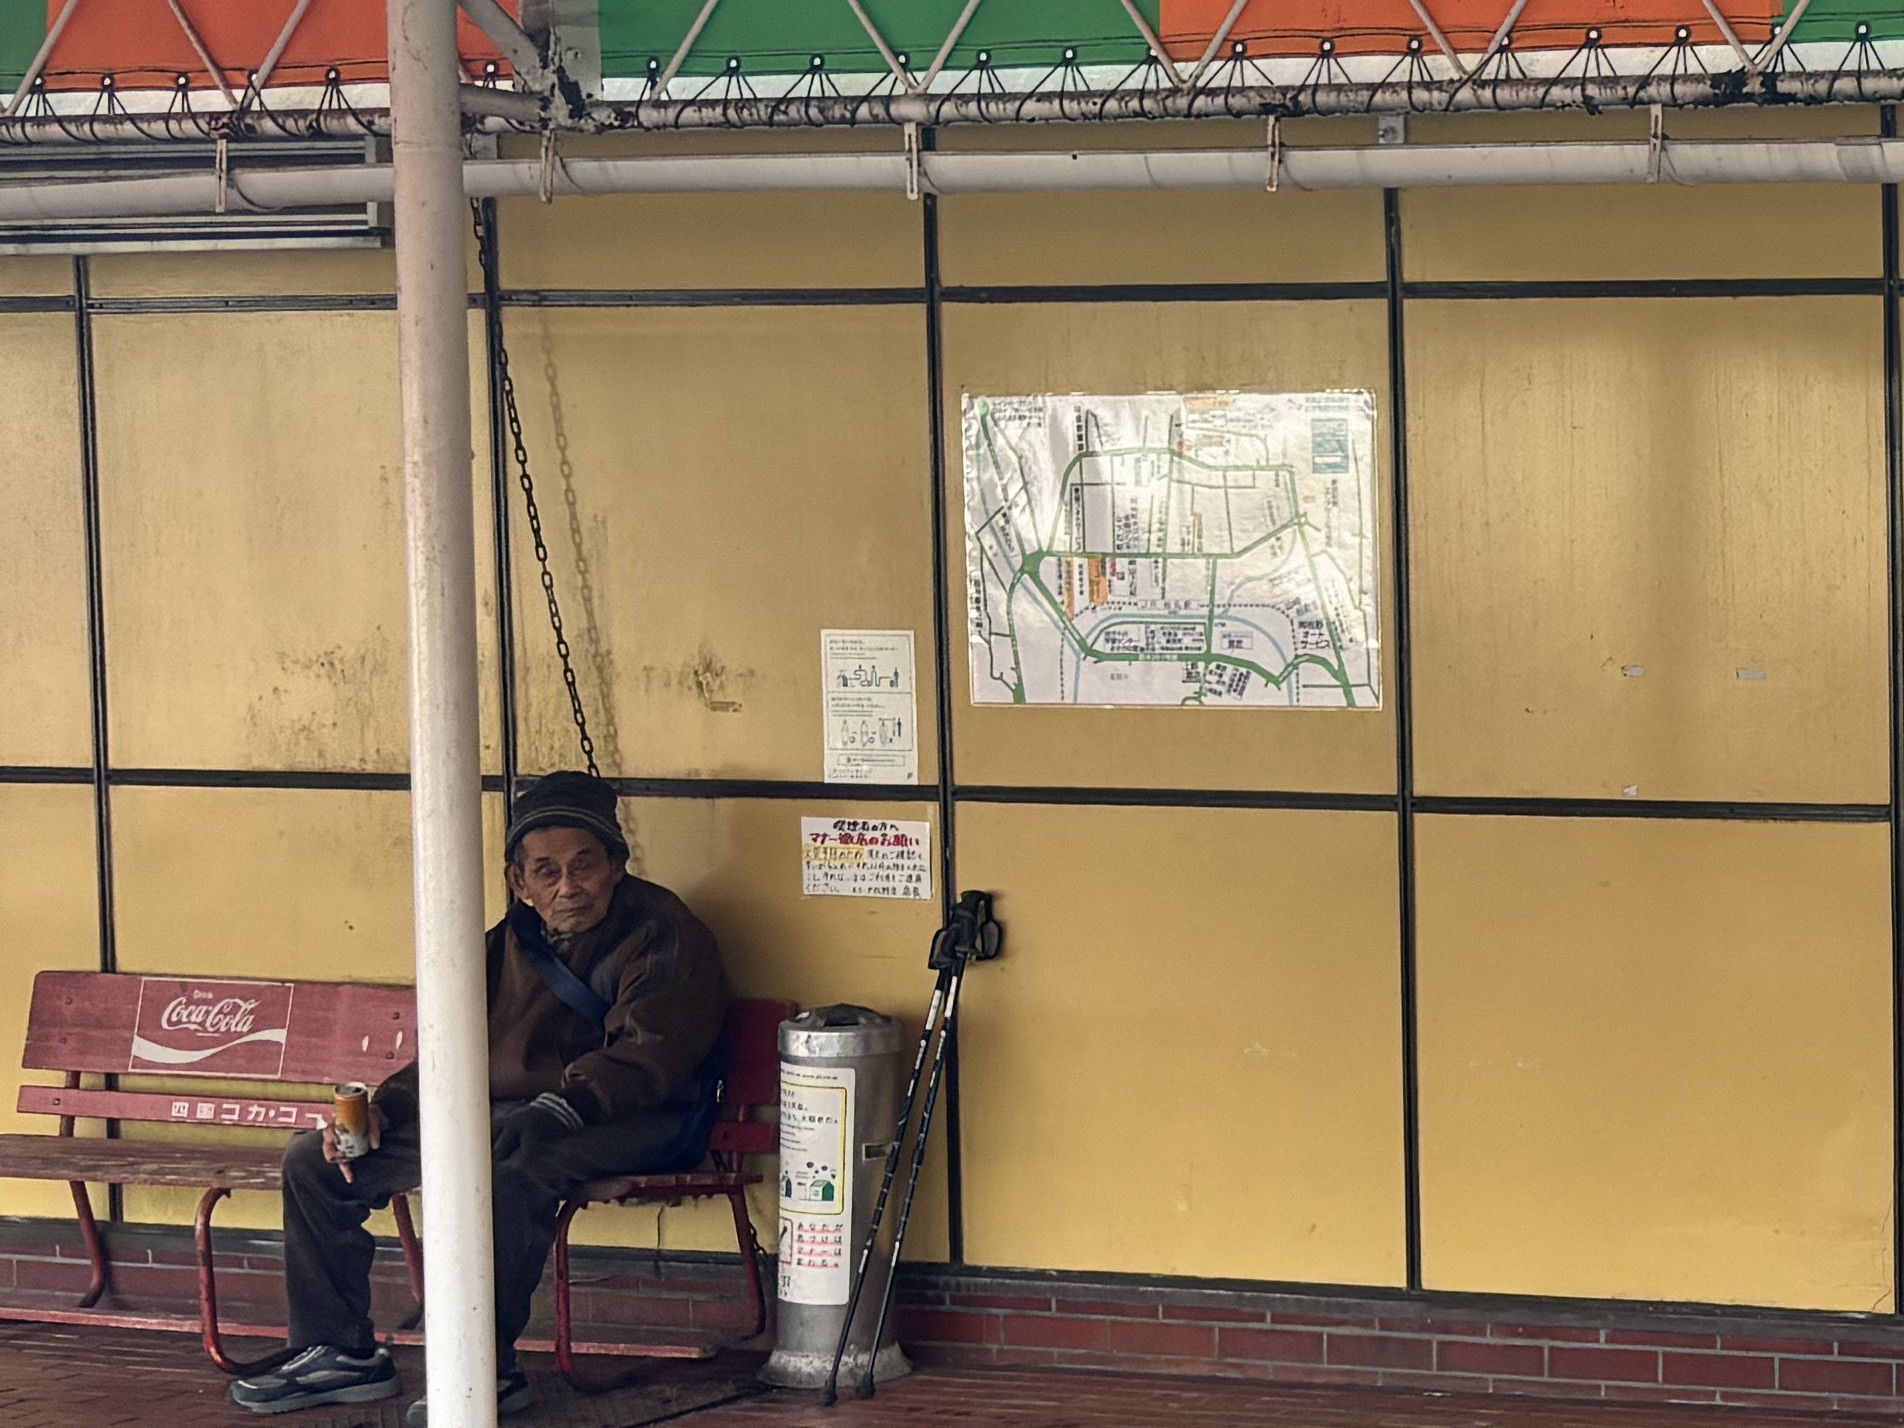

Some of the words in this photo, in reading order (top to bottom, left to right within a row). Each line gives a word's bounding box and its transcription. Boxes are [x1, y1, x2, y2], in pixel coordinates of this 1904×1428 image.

[161, 995, 260, 1034] Coca-Cola
[171, 1101, 327, 1129] 四国コカ・コー
